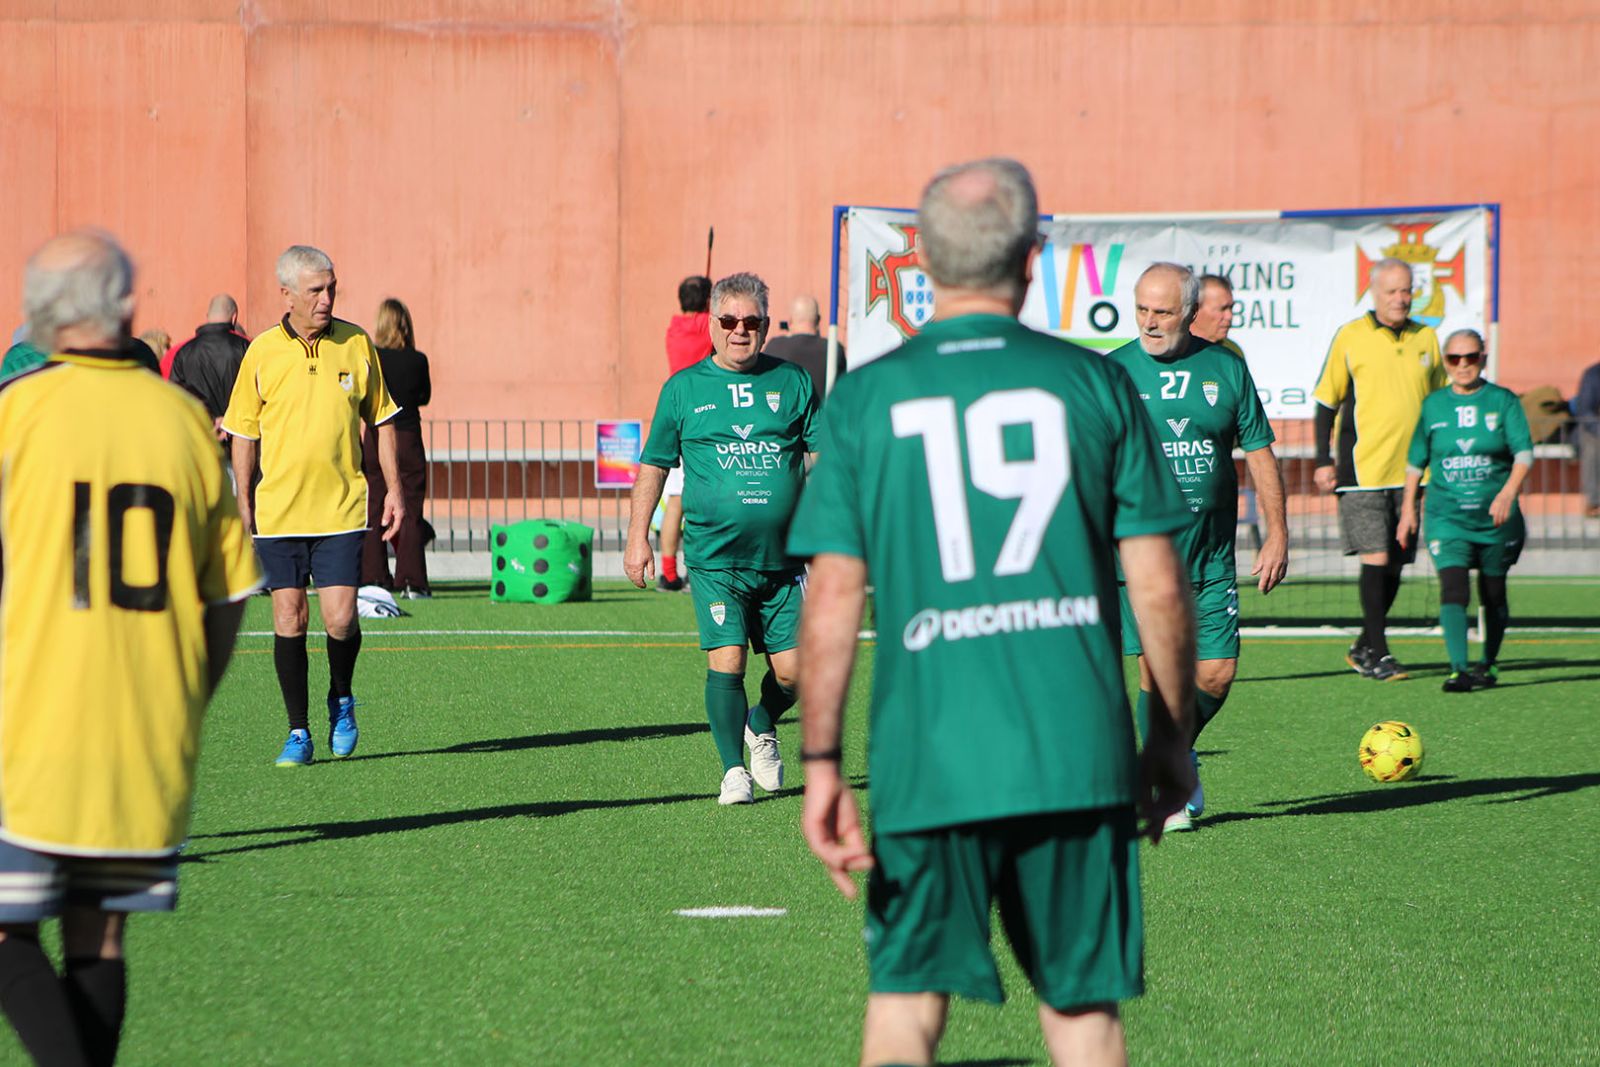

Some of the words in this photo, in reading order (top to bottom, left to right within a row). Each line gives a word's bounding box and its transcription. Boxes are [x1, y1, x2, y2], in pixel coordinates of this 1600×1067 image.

[1208, 244, 1243, 256] FPF
[1159, 370, 1191, 399] 27
[727, 383, 754, 408] 15
[1455, 405, 1478, 428] 18
[715, 441, 781, 455] OEIRAS
[1161, 439, 1214, 457] EIRAS
[717, 454, 782, 470] VALLEY
[1170, 456, 1214, 475] LLEY
[1442, 455, 1491, 469] OEIRAS
[890, 387, 1071, 582] 19
[1443, 467, 1492, 483] VALLEY
[73, 481, 175, 612] 10
[941, 596, 1098, 641] DECATHLON
